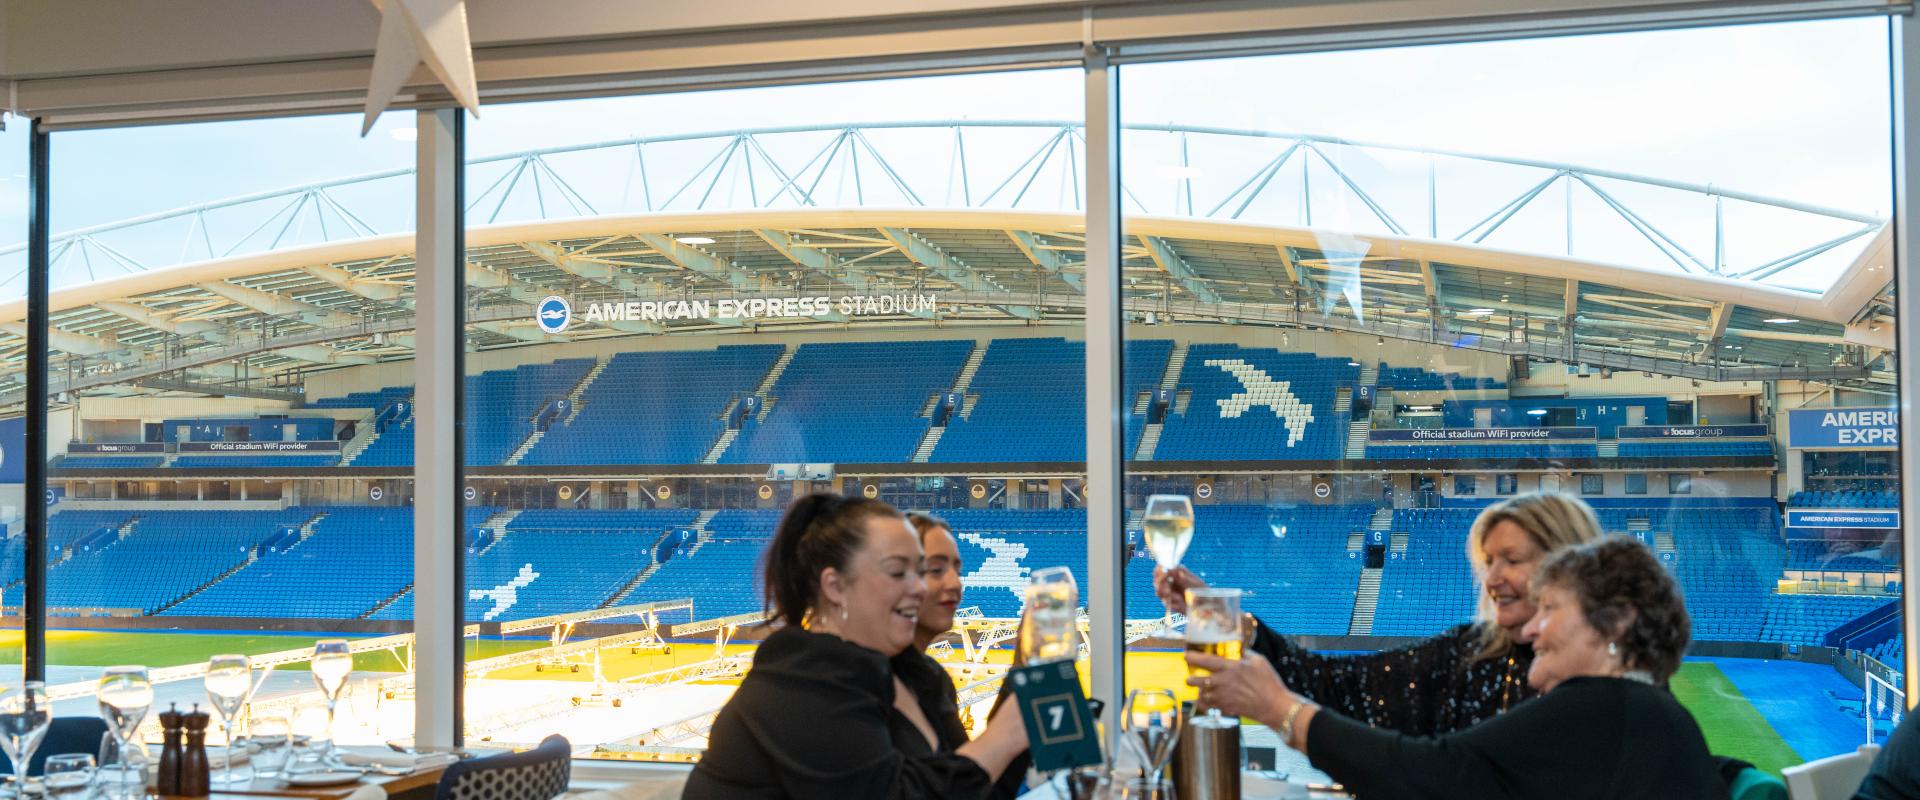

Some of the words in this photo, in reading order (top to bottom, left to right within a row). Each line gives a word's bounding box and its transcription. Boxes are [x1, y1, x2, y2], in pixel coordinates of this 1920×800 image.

[586, 300, 709, 322] AMERICAN
[718, 297, 830, 318] EXPRESS
[840, 294, 936, 316] STADIUM
[1160, 390, 1167, 399] F
[1360, 386, 1368, 396] G
[747, 397, 754, 406] D
[948, 394, 955, 403] E
[397, 403, 403, 411] B
[557, 400, 564, 409] C
[1597, 405, 1606, 415] H
[204, 425, 211, 433] A
[1412, 430, 1446, 439] Official
[1448, 430, 1485, 438] stadium
[1487, 429, 1508, 438] WiFi
[1510, 429, 1550, 439] provider
[210, 442, 234, 450] Official
[263, 442, 279, 450] WiFi
[280, 442, 308, 452] provider
[682, 530, 689, 540] D
[1129, 531, 1136, 541] F
[1374, 531, 1382, 541] G
[1636, 532, 1645, 542] H
[1048, 705, 1064, 731] 7
